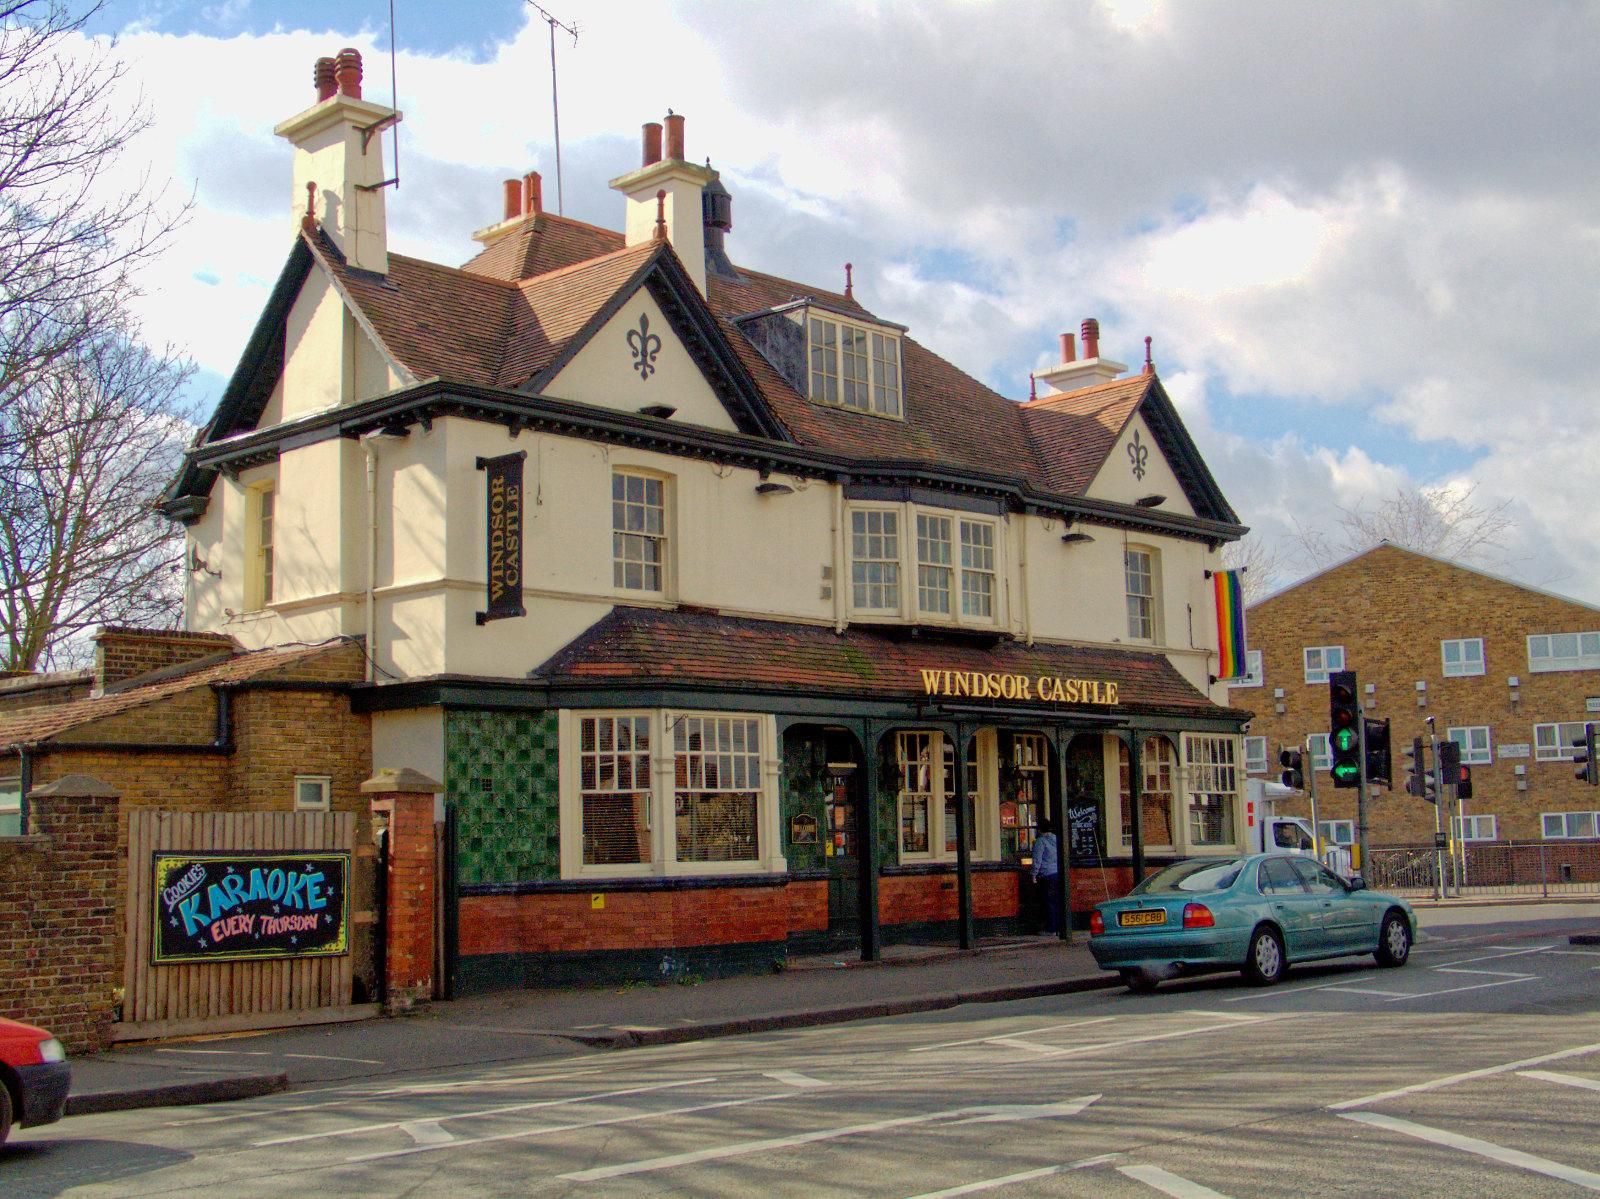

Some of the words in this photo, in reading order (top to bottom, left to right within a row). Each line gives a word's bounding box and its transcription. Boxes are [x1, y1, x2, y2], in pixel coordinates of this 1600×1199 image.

[492, 475, 504, 602] WINDSOR
[506, 485, 519, 587] CASTLE
[919, 669, 1031, 700] WINDSOR
[1037, 676, 1119, 705] CASTLE
[179, 868, 326, 936] KARAOKE
[210, 914, 256, 943] EVERY
[260, 913, 319, 935] THURSDAY
